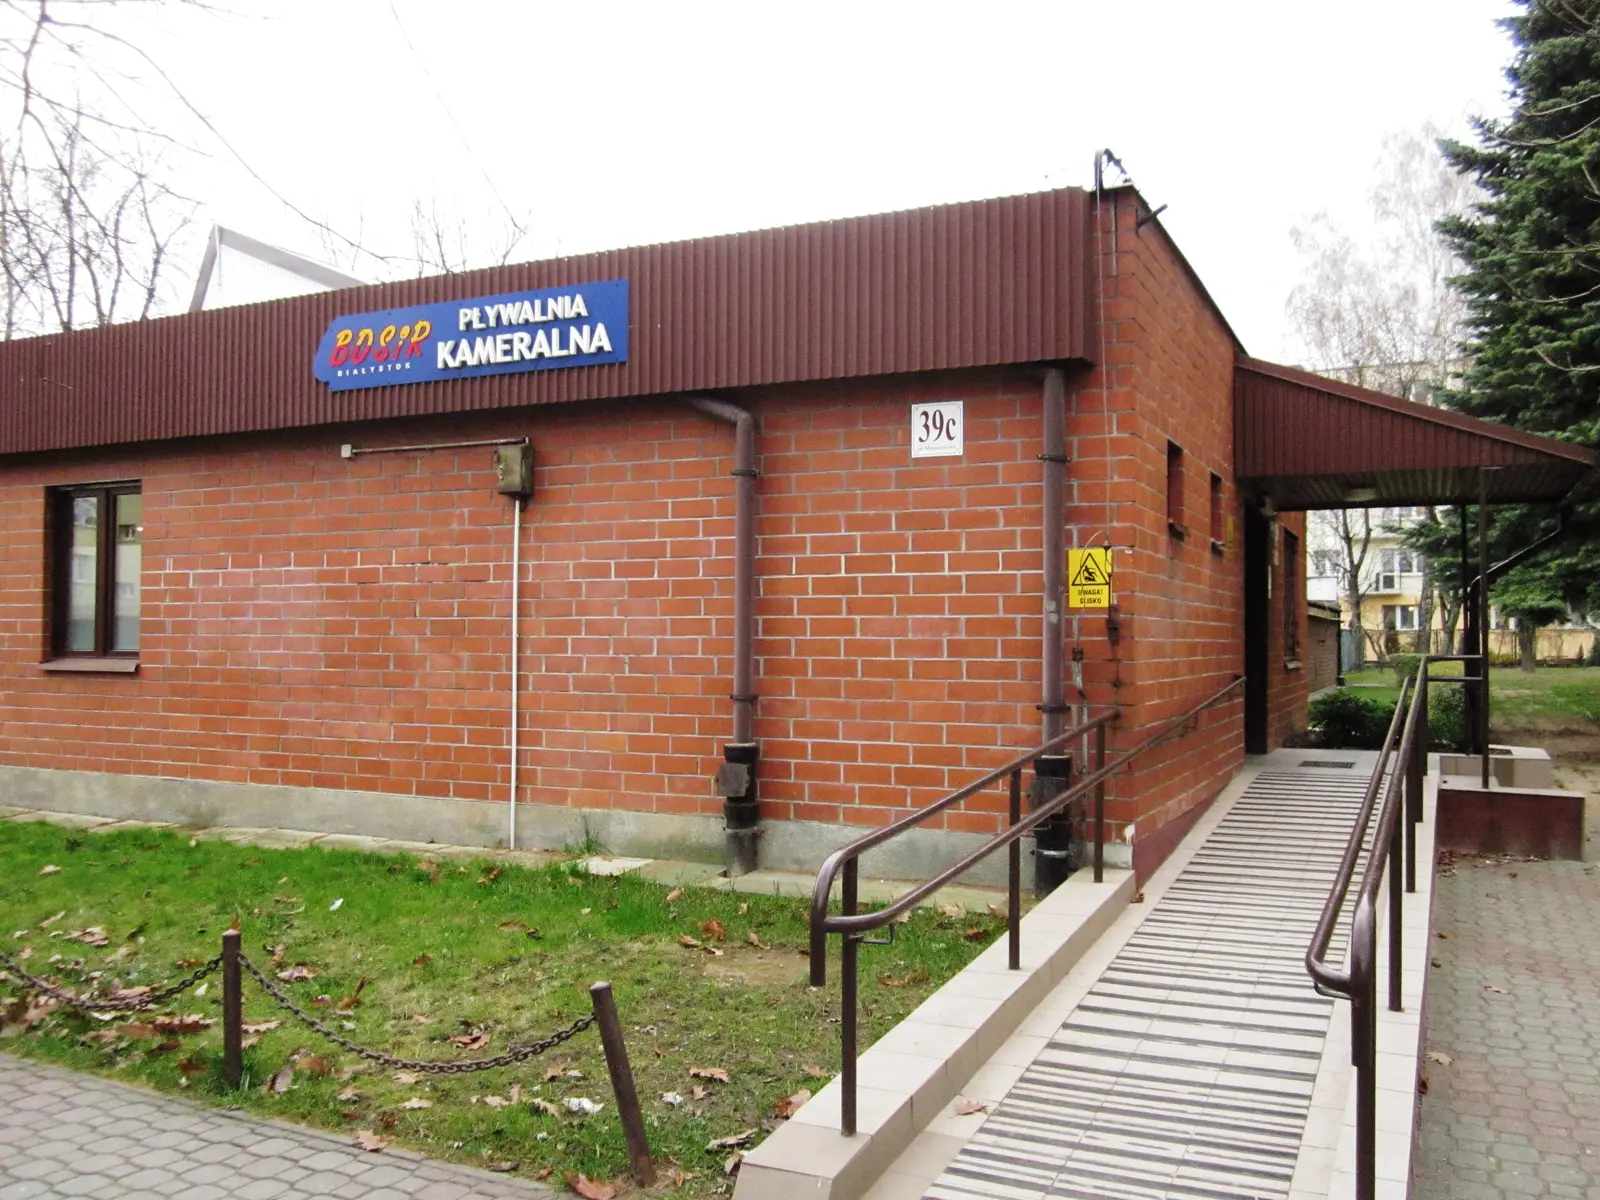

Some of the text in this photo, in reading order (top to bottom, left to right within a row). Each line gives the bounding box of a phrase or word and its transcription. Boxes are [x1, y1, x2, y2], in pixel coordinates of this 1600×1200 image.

[459, 293, 588, 331] PŁYWALNIA
[437, 322, 612, 369] KAMERALNA
[918, 409, 956, 443] 39c
